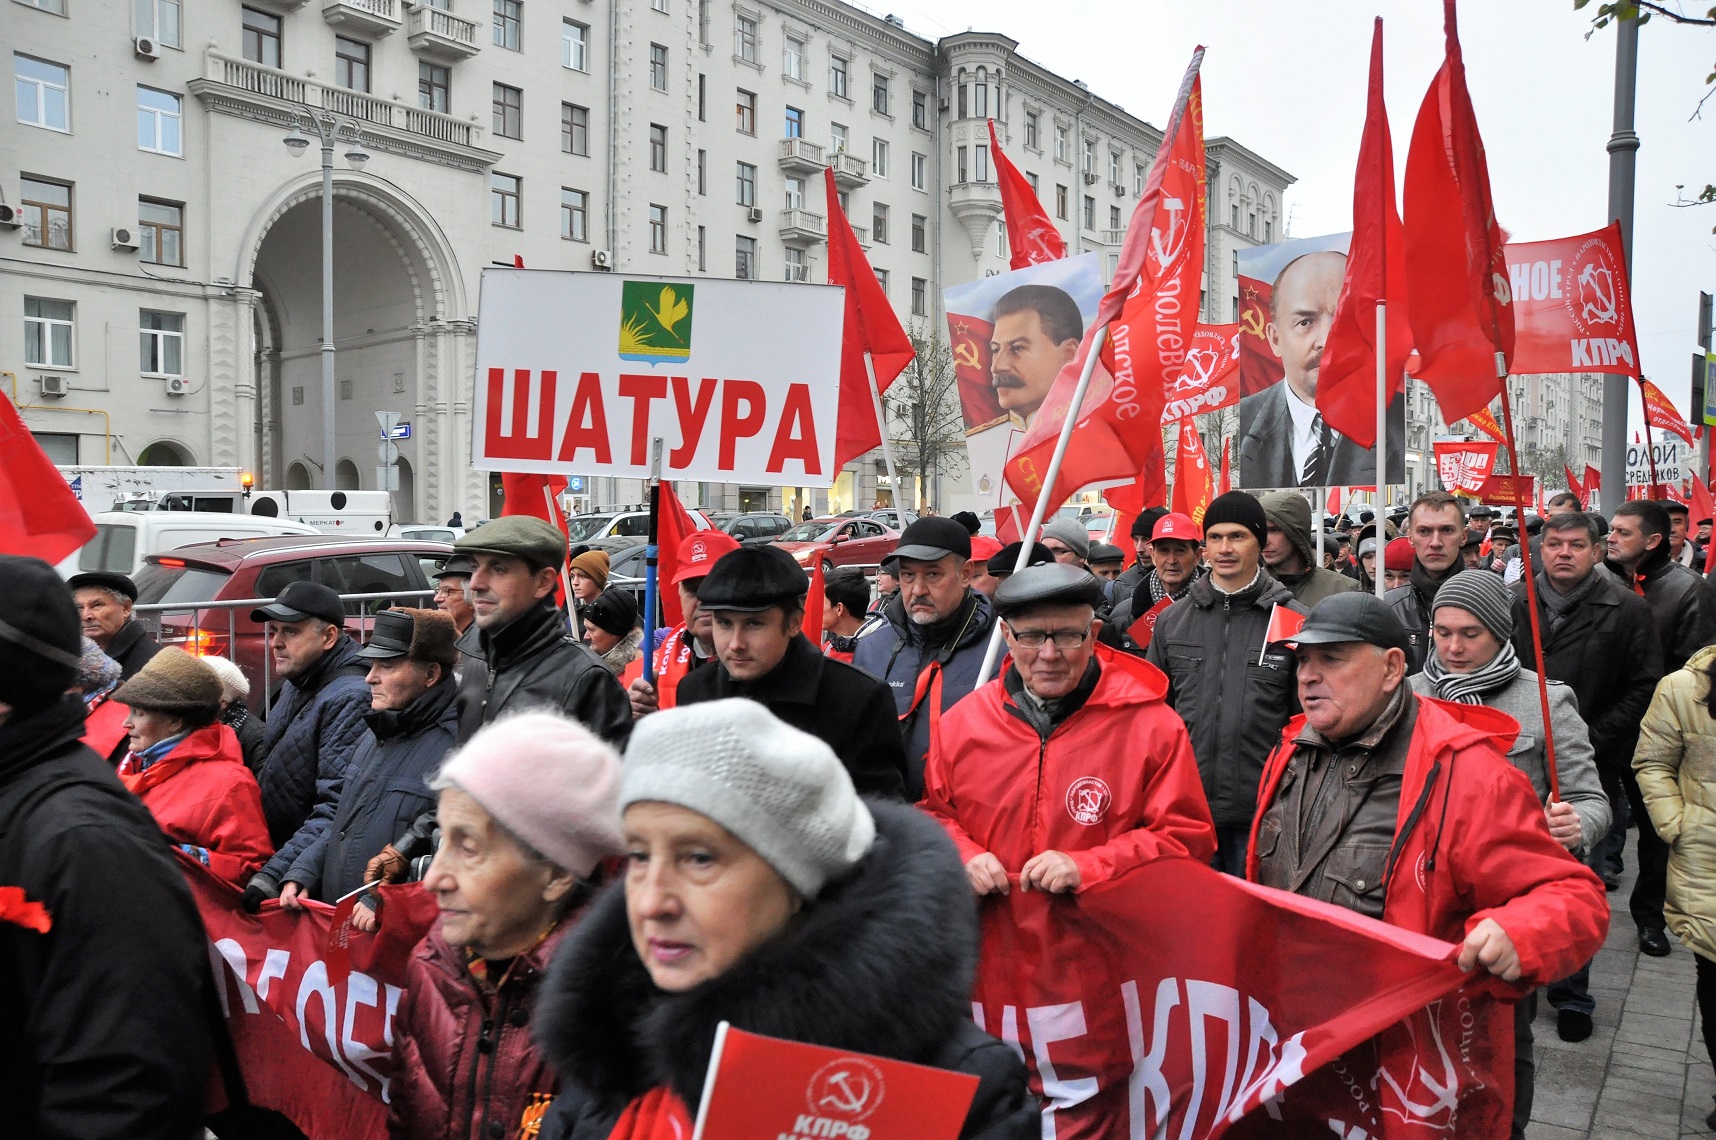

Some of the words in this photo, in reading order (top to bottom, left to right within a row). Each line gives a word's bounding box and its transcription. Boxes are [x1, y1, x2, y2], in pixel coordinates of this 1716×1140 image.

[1507, 259, 1563, 302] НОЕ
[1570, 338, 1634, 369] КПРФ
[484, 367, 822, 476] ШАТУРА
[1075, 811, 1099, 823] КПРФ
[793, 1113, 871, 1140] КПРФ
